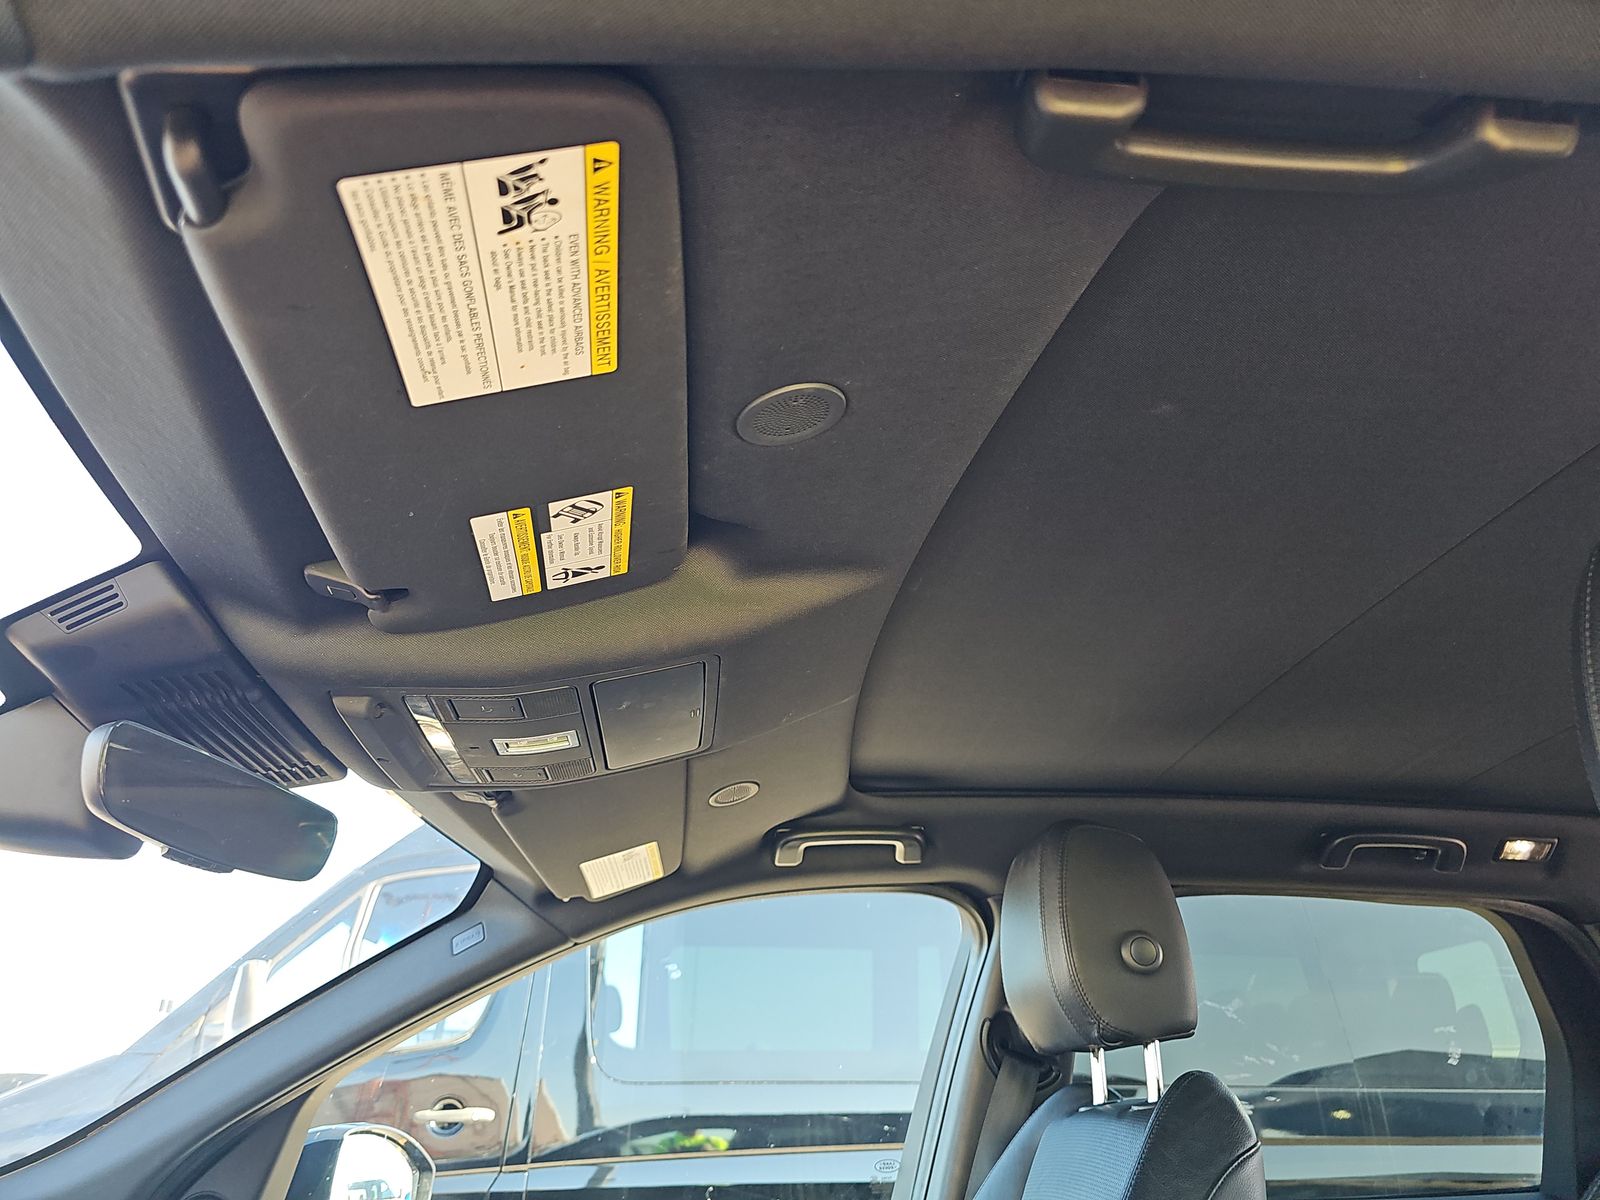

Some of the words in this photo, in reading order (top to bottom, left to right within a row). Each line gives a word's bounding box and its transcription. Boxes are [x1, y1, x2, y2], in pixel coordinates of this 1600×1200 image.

[446, 205, 461, 231] AVEC
[592, 181, 609, 256] WARNING
[452, 233, 465, 251] DES
[568, 233, 579, 256] EVEN
[456, 253, 470, 278] SACS
[569, 258, 580, 280] WITH
[461, 279, 481, 332] GONFLABLES
[571, 281, 582, 323] ADVANCED
[594, 266, 610, 368] AVERTISSEMENT
[573, 324, 584, 356] AIRBAGS
[614, 498, 626, 528] WARNING:
